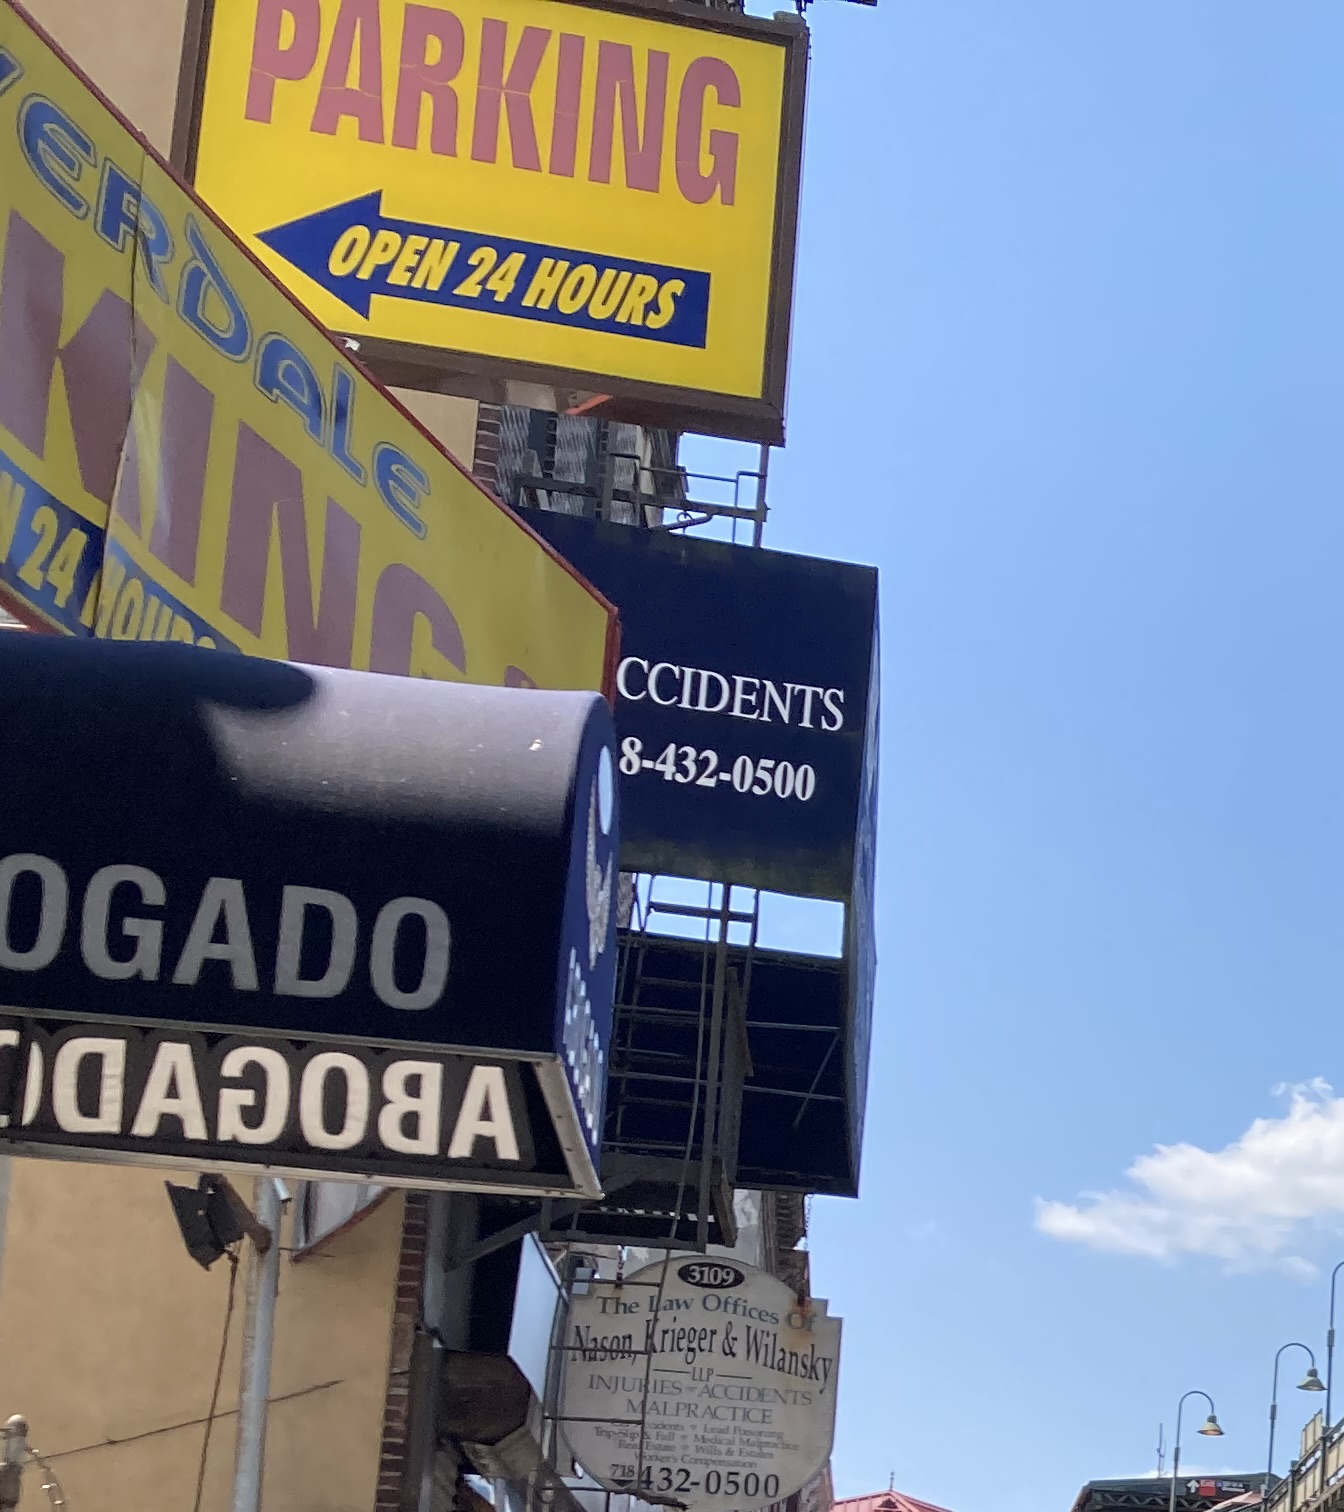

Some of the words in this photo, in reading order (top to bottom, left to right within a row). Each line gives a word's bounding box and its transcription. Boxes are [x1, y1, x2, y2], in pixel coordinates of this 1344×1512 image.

[244, 0, 742, 206] PARKING
[0, 45, 431, 540] ERDALE
[328, 224, 461, 292] OPEN
[452, 243, 517, 304] 24
[526, 258, 686, 329] HOURS
[17, 505, 88, 608] 24
[80, 554, 216, 649] HOU
[616, 655, 845, 733] CCIDENTS
[619, 736, 816, 801] 8-432-0500
[0, 852, 452, 1013] OGADO
[687, 1266, 735, 1286] 3109
[596, 1296, 639, 1315] The
[648, 1295, 694, 1314] Law
[701, 1293, 779, 1325] Offices
[785, 1312, 817, 1331] Of
[571, 1325, 637, 1366] Nason,
[645, 1316, 718, 1365] Krieger
[722, 1320, 738, 1358] &
[746, 1324, 833, 1394] Wilansky
[588, 1374, 683, 1397] INJURIES
[698, 1383, 812, 1407] ACCIDENTS
[690, 1366, 714, 1382] LLP
[626, 1399, 774, 1424] MALPRACTICE
[610, 1464, 635, 1478] 718
[640, 1465, 780, 1498] 432-0500
